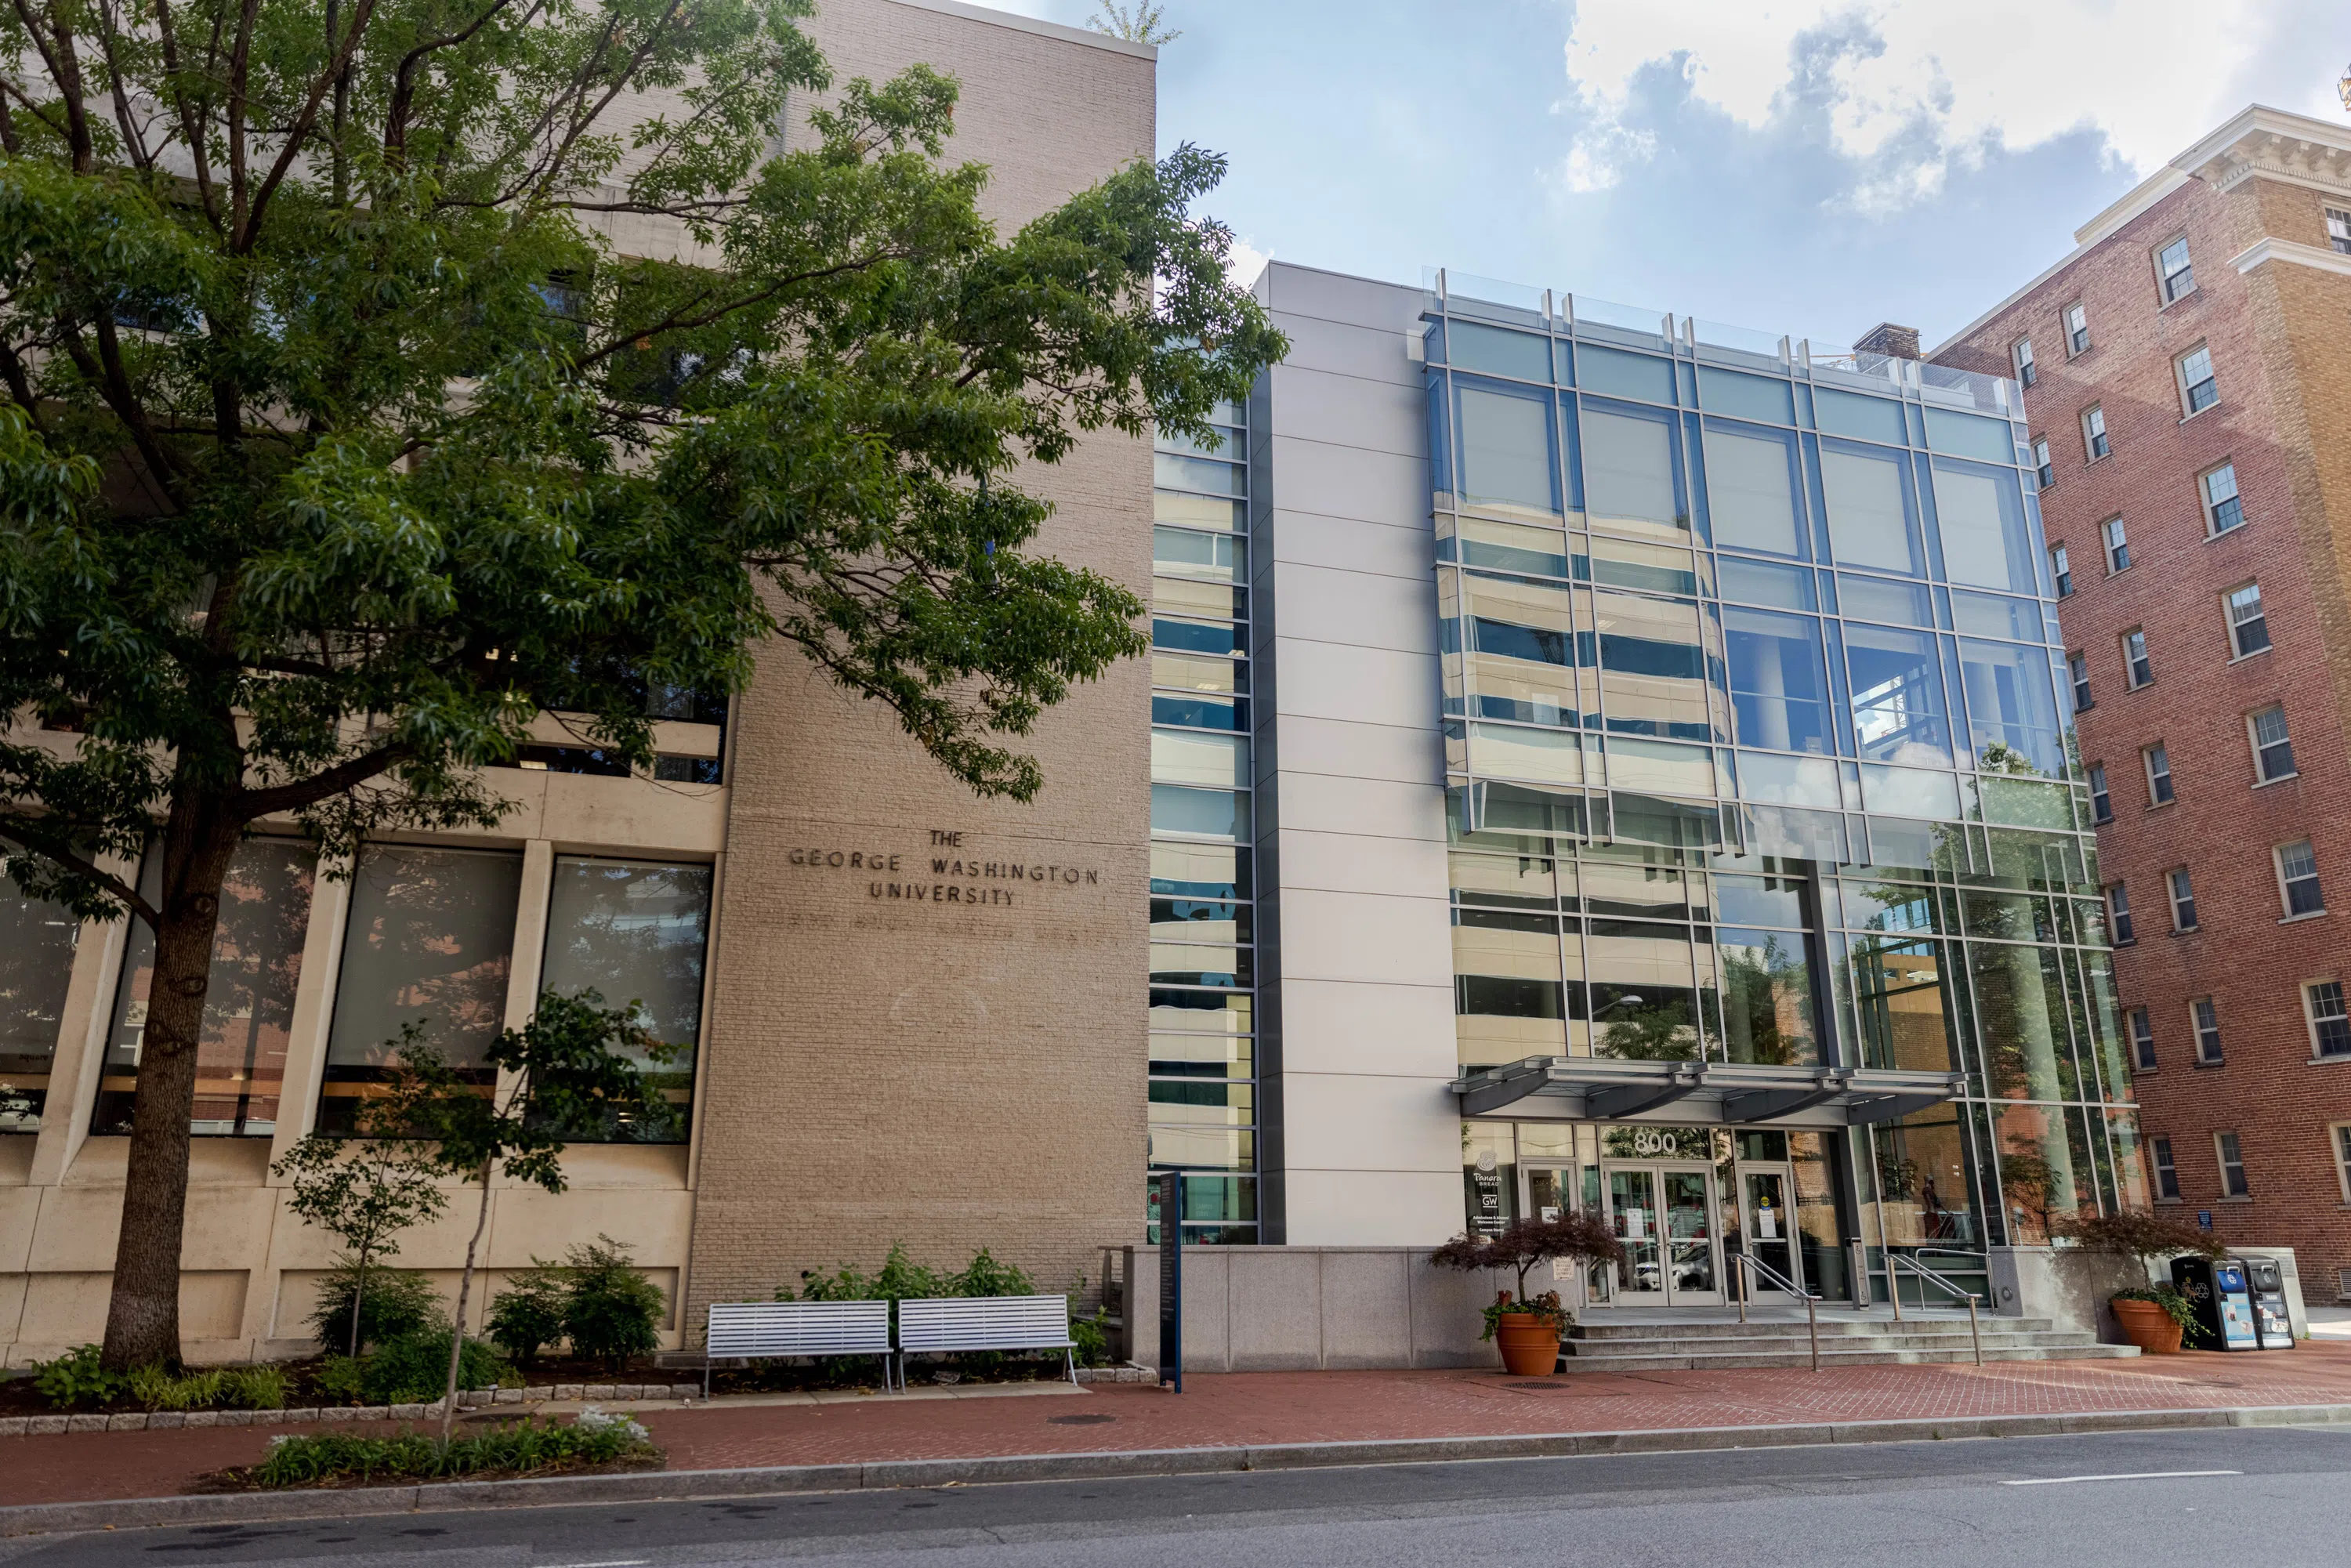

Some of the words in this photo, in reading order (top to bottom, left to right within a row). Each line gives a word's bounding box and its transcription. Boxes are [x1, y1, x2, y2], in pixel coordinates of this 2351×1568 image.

[931, 830, 962, 847] THE
[789, 849, 900, 871] GEORGE
[932, 858, 1097, 884] WASHINGTON
[870, 882, 1013, 905] UNIVERSITY
[1635, 1132, 1676, 1153] 800
[1473, 1173, 1502, 1182] Panera
[1482, 1197, 1498, 1206] GW
